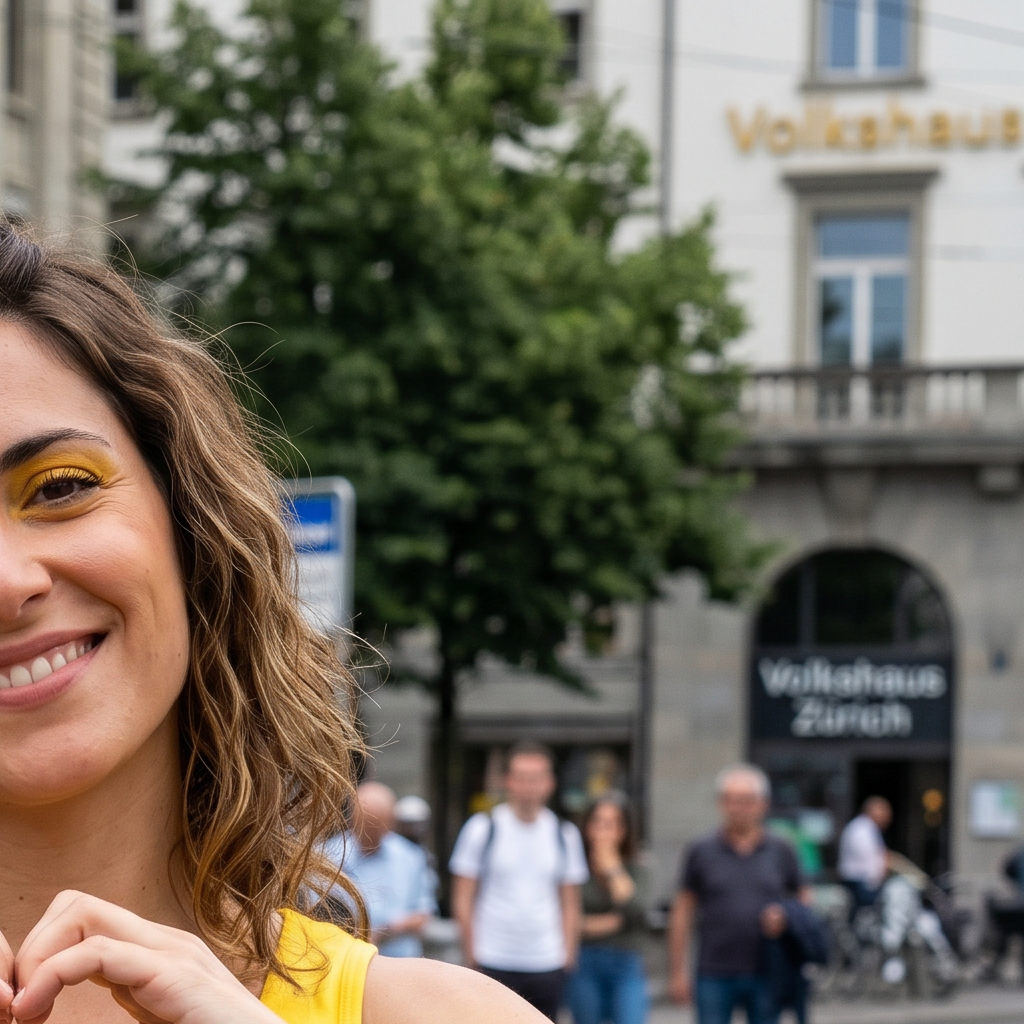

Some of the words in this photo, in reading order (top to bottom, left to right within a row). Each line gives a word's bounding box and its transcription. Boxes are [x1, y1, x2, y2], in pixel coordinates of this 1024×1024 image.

[726, 98, 1024, 154] Volkshaus
[758, 656, 947, 699] Volkshaus
[791, 698, 912, 737] Zürich
